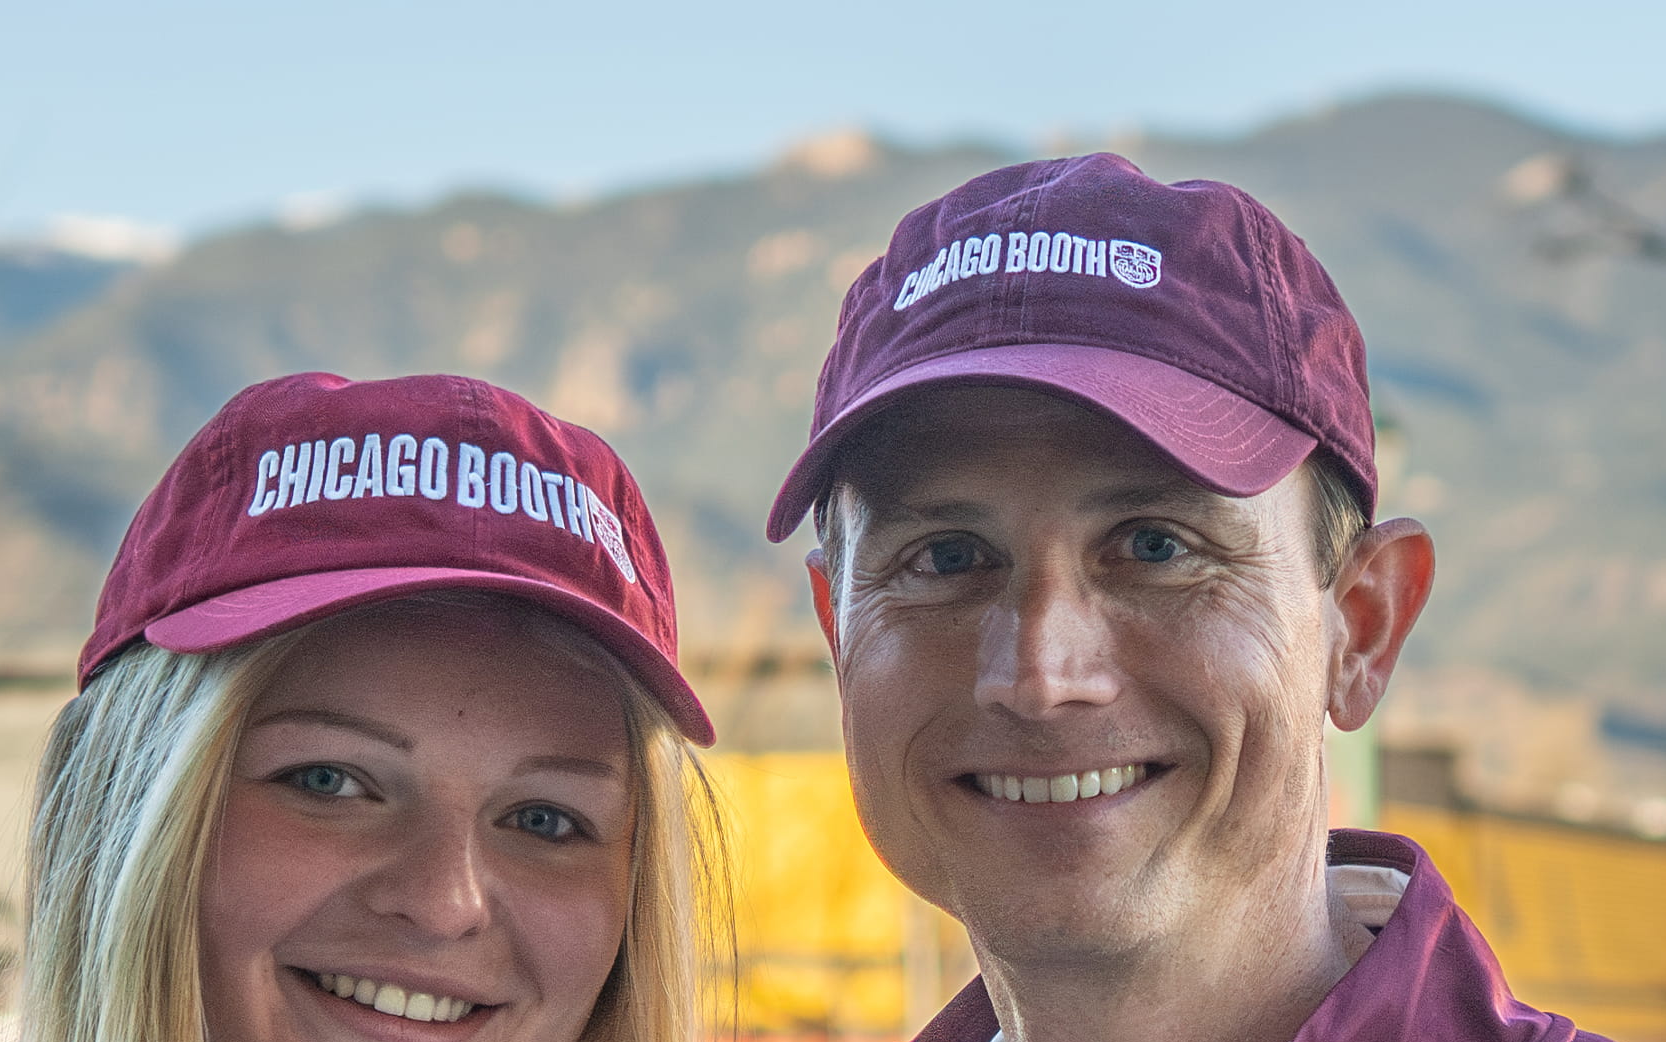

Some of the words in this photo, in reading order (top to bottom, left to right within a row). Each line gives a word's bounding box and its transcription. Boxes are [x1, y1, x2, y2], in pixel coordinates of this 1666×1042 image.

[893, 232, 1002, 311] CHICAGO
[1005, 231, 1107, 277] BOOTH
[247, 433, 450, 517] CHICAGO
[457, 441, 595, 544] BOOTH
